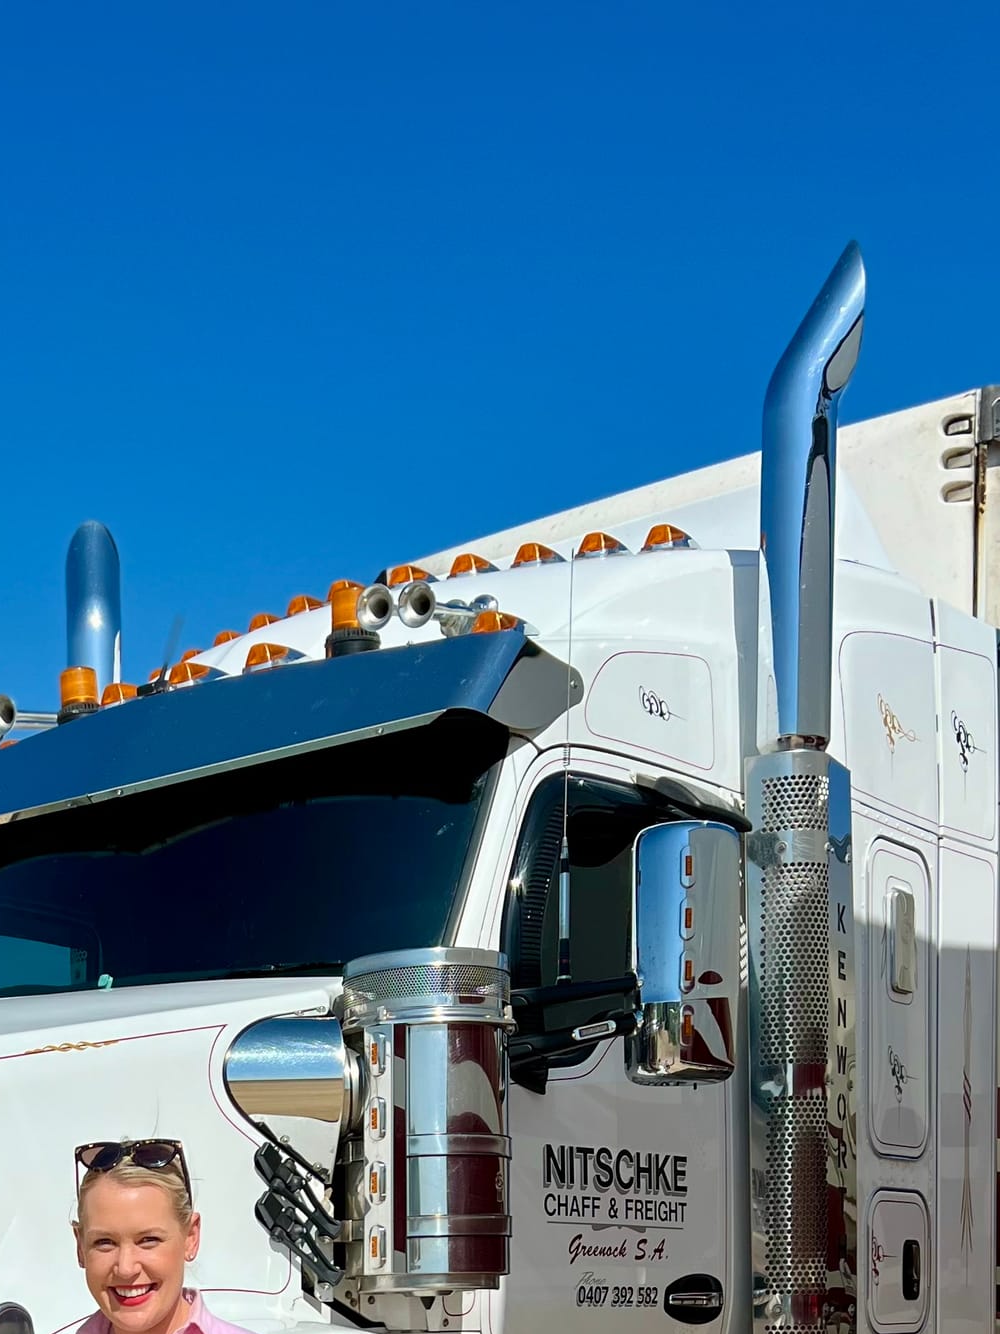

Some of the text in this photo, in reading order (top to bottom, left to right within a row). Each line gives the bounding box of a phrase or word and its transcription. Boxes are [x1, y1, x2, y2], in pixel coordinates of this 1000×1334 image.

[543, 1144, 688, 1197] NITSCHKE
[544, 1193, 687, 1222] CHAFF & FREIGHT
[568, 1234, 627, 1264] Greenock
[576, 1286, 658, 1307] 0407 392 582
